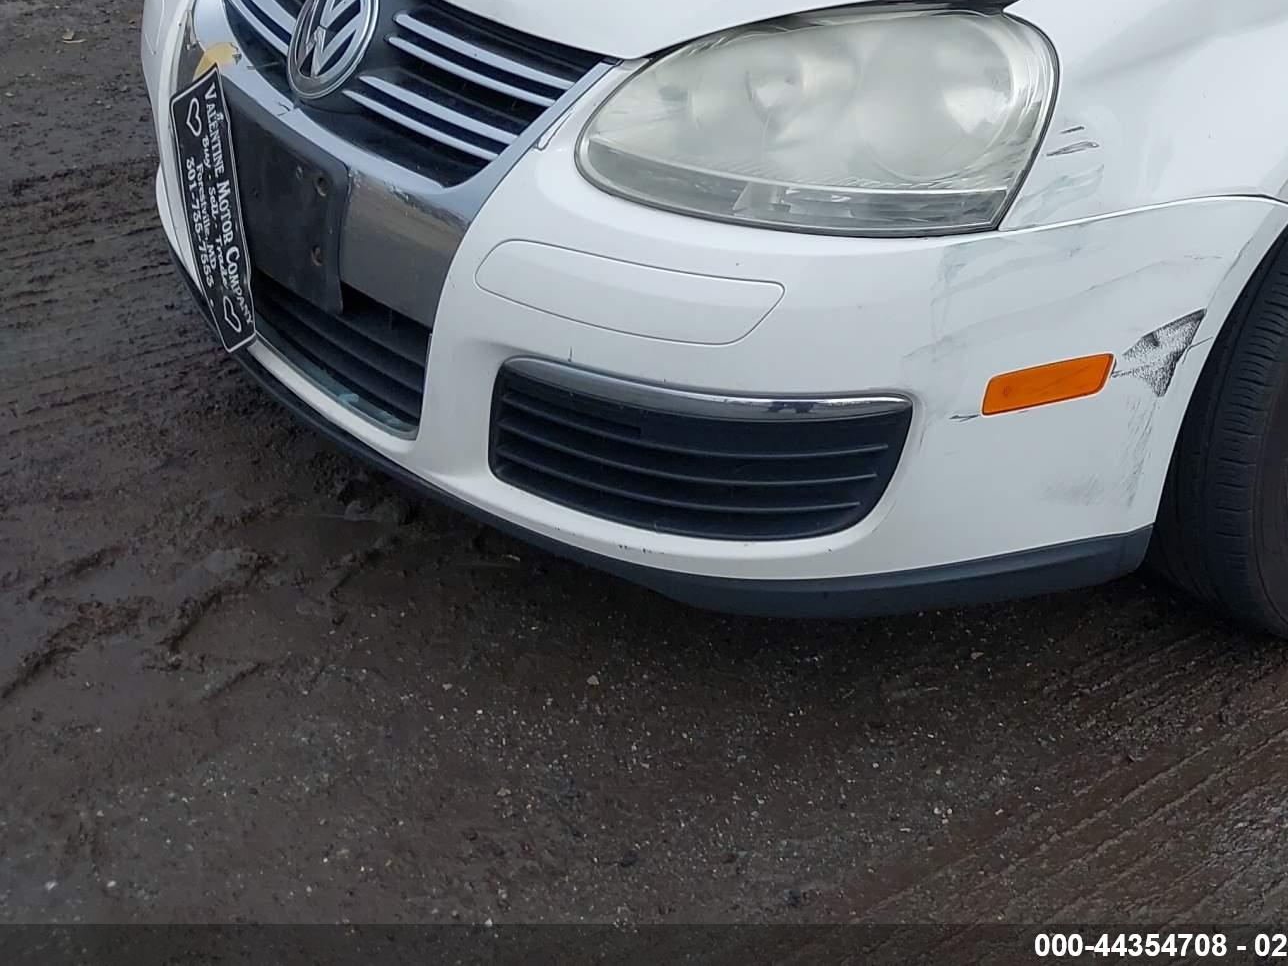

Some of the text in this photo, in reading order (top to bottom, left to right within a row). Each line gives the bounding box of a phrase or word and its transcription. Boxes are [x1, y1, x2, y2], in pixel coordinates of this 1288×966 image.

[186, 156, 215, 288] 301-735-7553
[201, 135, 211, 168] Buy
[208, 186, 219, 220] Sell
[215, 234, 229, 290] Trade
[204, 82, 254, 324] VALENTINE MOTOR COMPANY
[206, 243, 217, 270] MD
